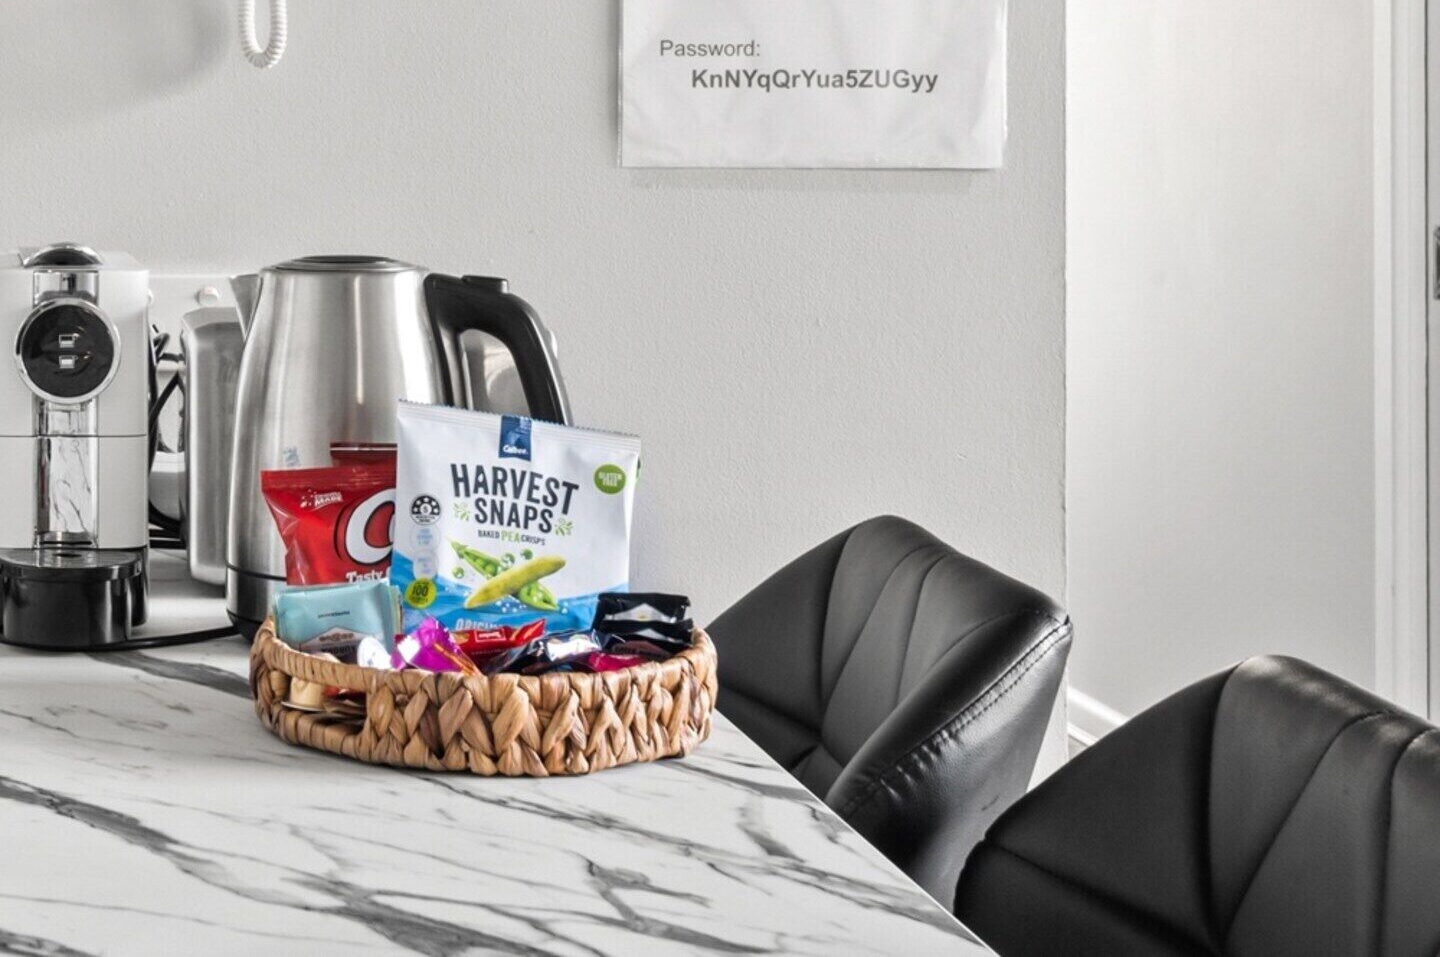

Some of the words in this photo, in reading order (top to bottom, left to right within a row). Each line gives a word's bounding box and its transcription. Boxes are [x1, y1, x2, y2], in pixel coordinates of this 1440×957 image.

[660, 39, 761, 57] Password:
[691, 68, 939, 93] KnNYqQrYua5ZUGyy
[450, 463, 580, 516] HARVEST
[474, 497, 554, 534] SNAPS
[478, 529, 500, 540] BAKED
[501, 531, 520, 544] PEA
